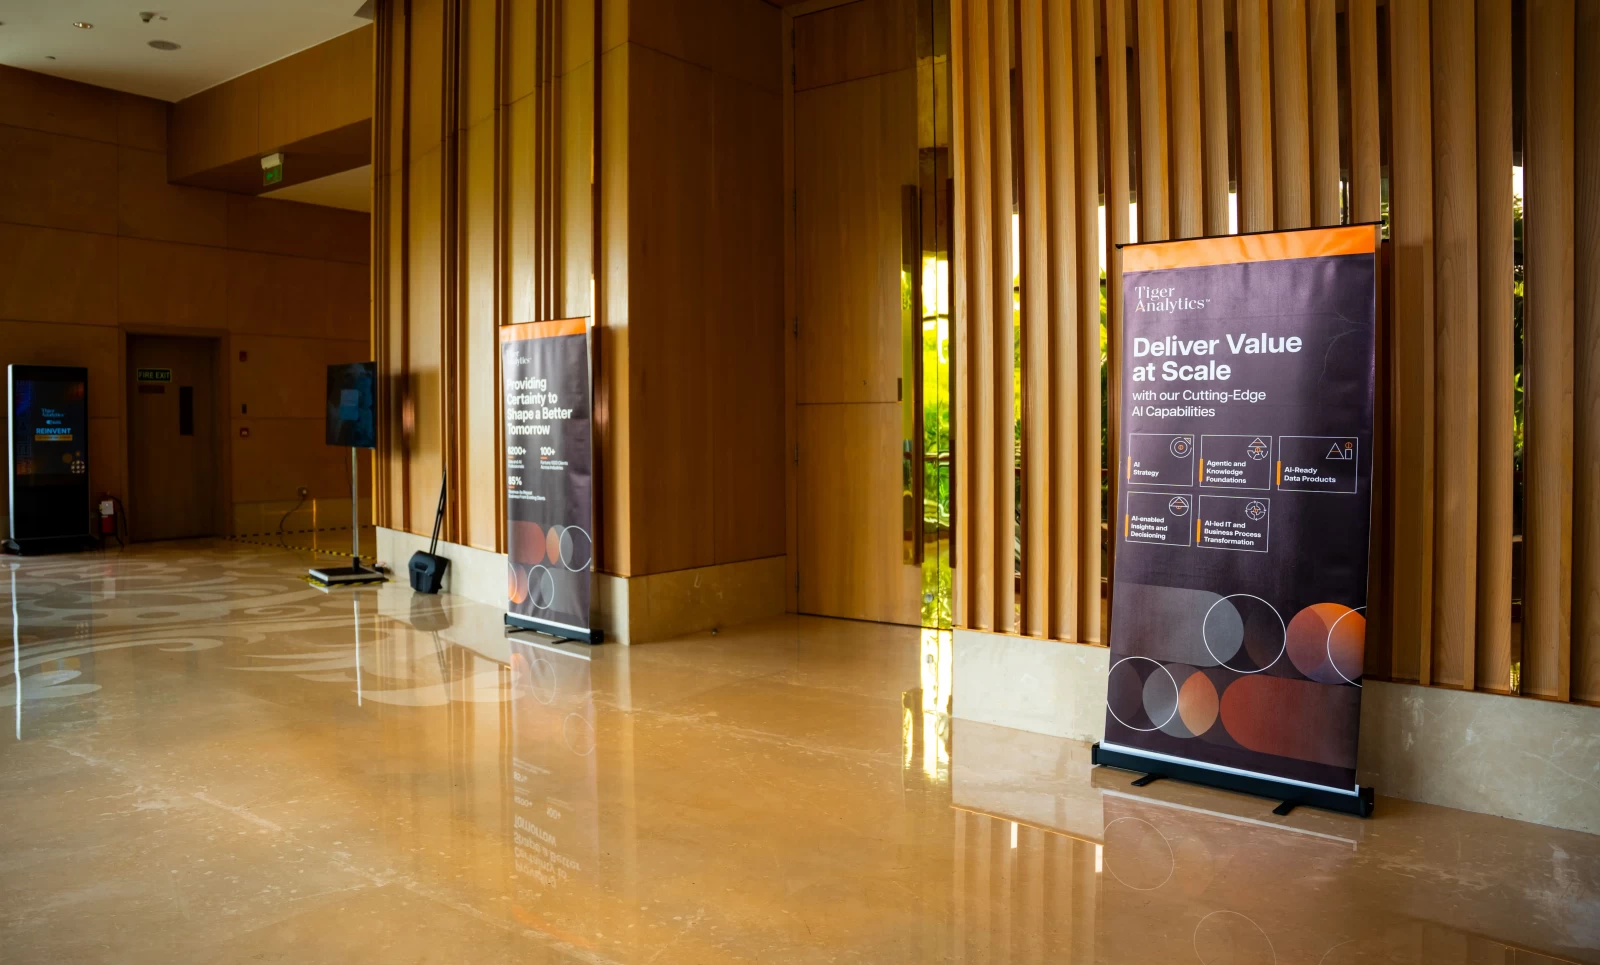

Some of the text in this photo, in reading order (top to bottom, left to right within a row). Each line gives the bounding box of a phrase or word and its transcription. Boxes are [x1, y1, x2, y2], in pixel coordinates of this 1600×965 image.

[1134, 286, 1176, 301] Tiger
[1134, 332, 1302, 358] Deliver Value
[139, 371, 170, 379] FIRE EXIT
[1132, 360, 1232, 382] at Scale
[506, 376, 547, 392] Providing
[506, 392, 558, 407] Certainty to
[1132, 389, 1266, 403] with our Cutting-Edge
[507, 406, 573, 423] Shape a Better
[1132, 406, 1215, 419] AI Capabilities
[507, 422, 550, 435] Tomorrow
[540, 446, 556, 456] 100+
[1206, 460, 1232, 468] Agentic
[508, 476, 522, 485] 85%
[1131, 531, 1166, 540] Decisioning
[1204, 537, 1254, 546] Transformation
